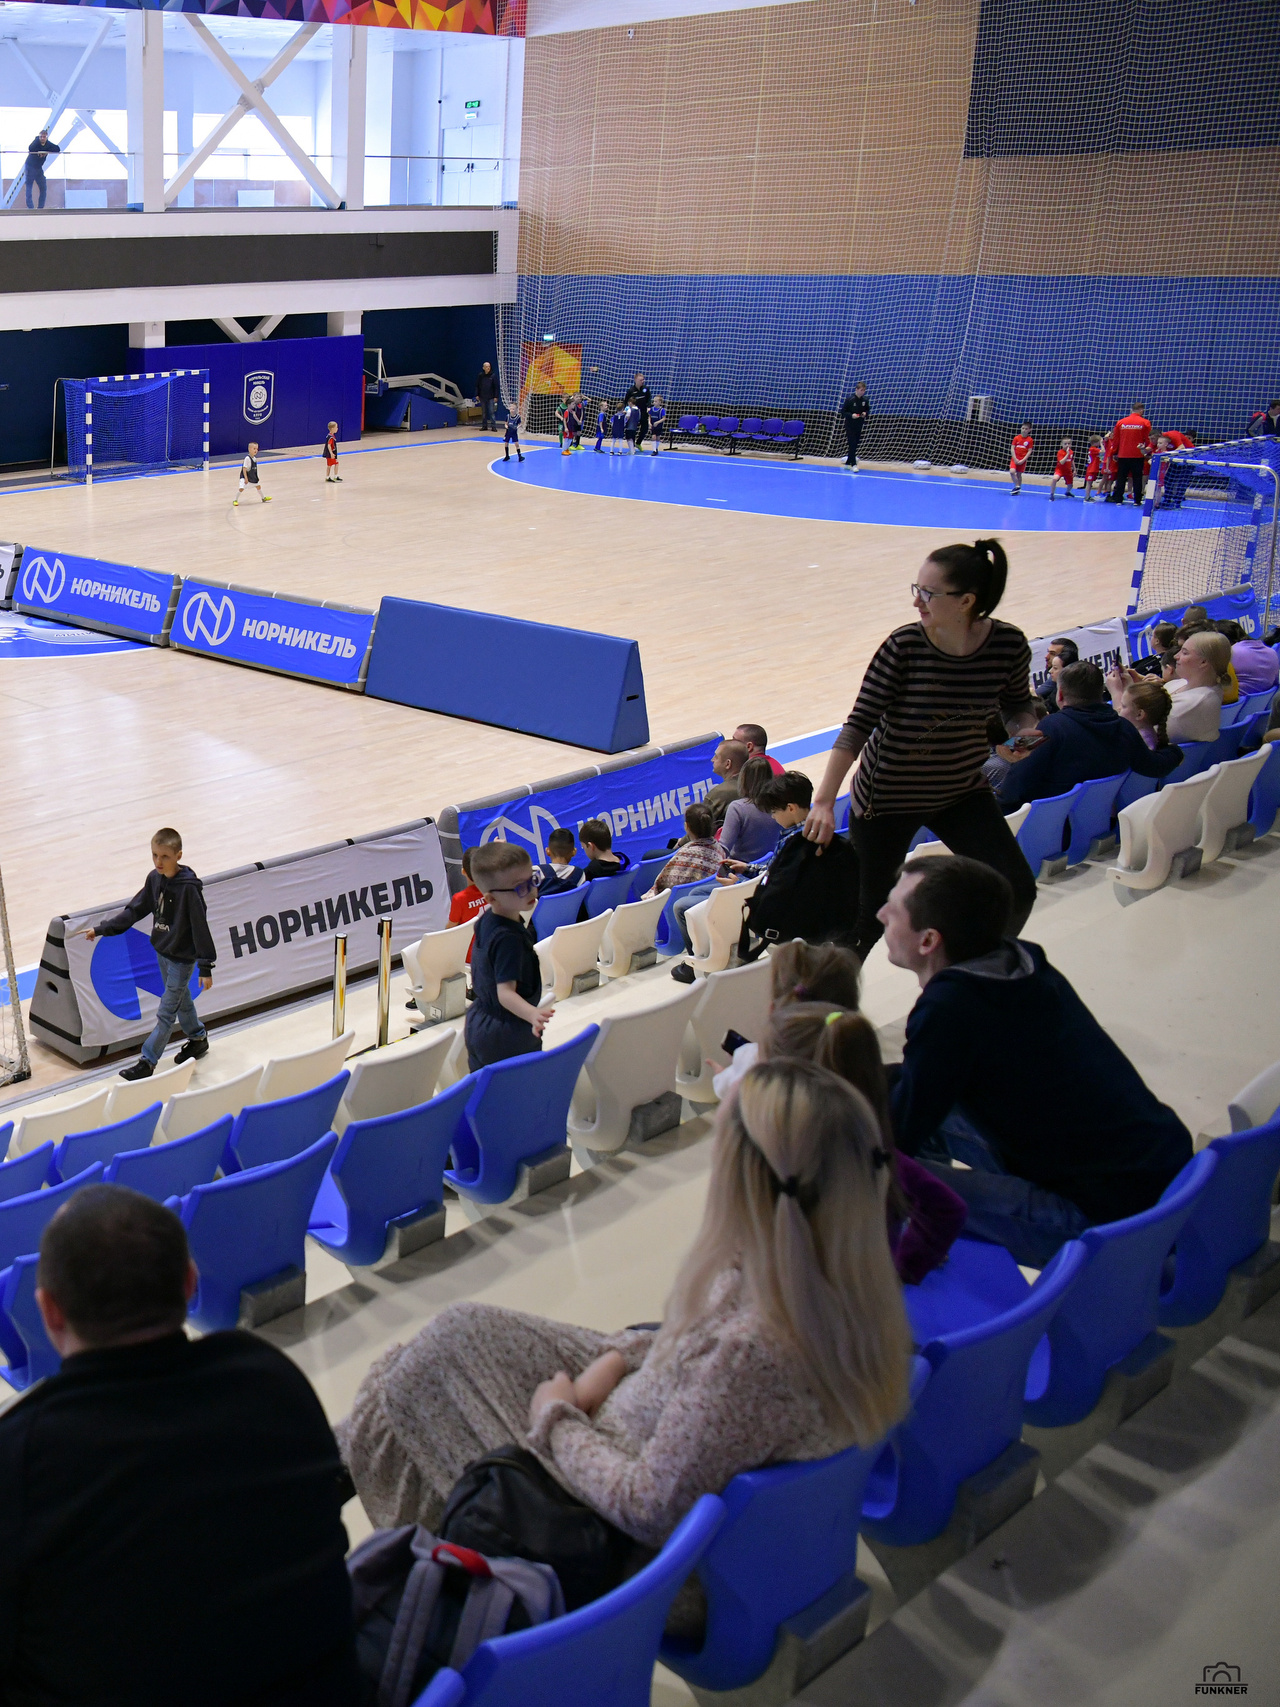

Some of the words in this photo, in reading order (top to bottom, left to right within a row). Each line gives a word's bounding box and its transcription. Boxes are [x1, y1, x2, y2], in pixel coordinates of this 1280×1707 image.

[70, 577, 161, 613] НОРНИКЕЛЬ
[241, 617, 357, 659] НОРНИКЕЛЬ
[229, 873, 434, 959] НОРНИКЕЛЬ
